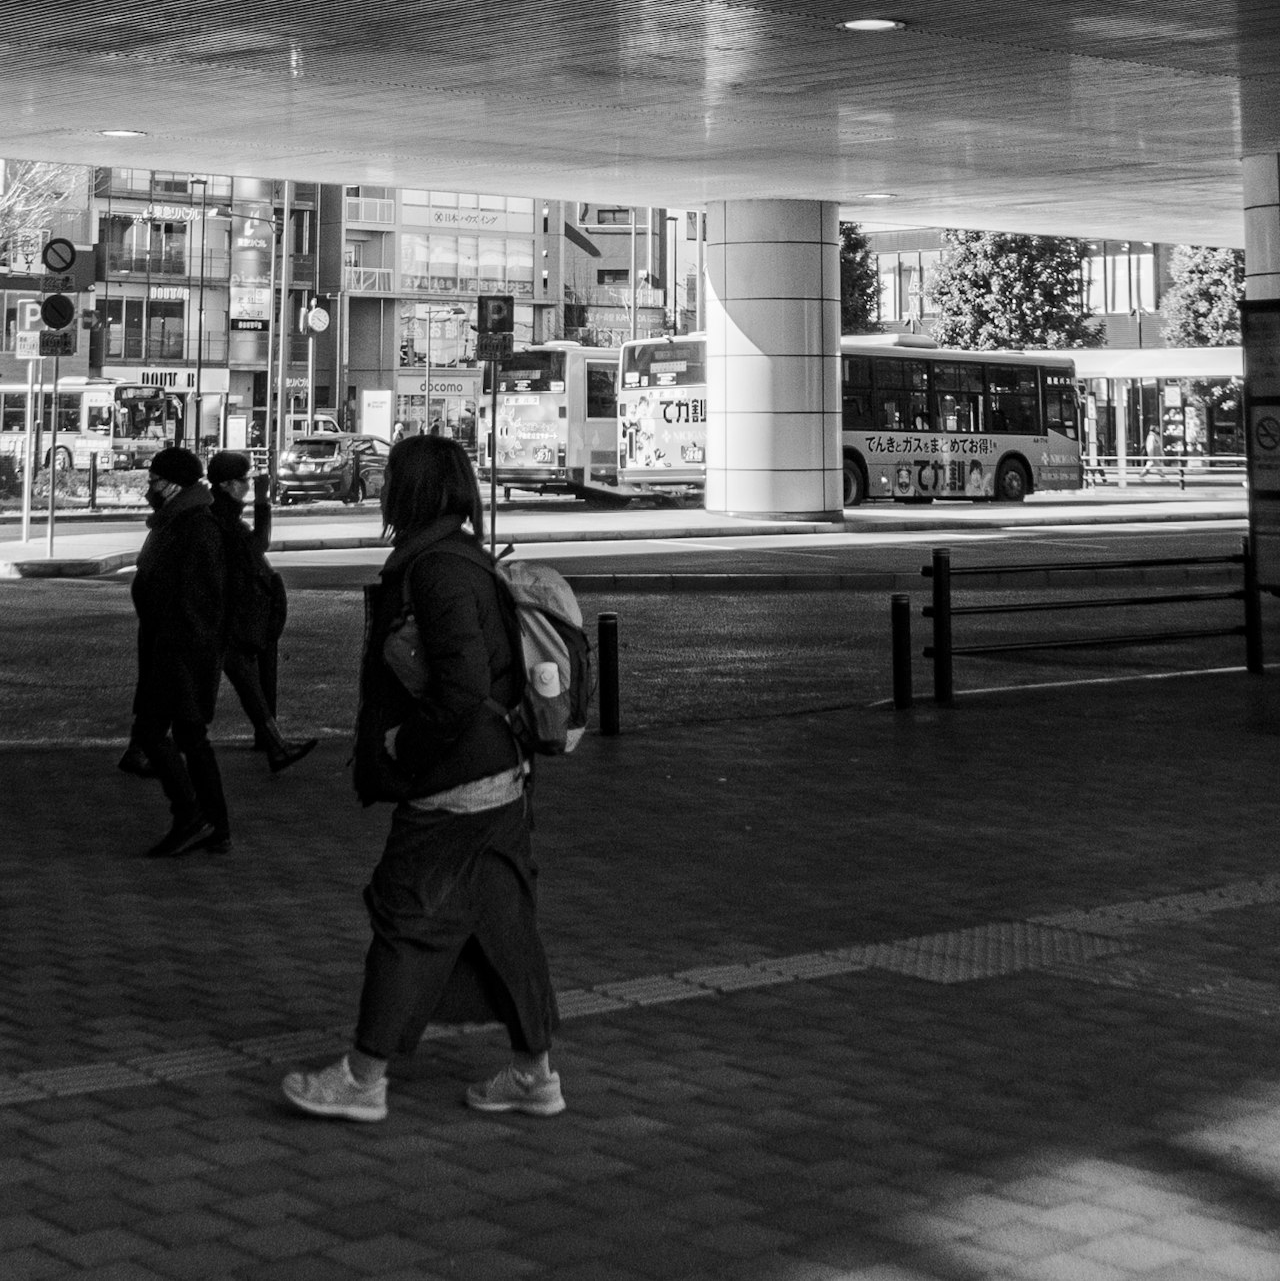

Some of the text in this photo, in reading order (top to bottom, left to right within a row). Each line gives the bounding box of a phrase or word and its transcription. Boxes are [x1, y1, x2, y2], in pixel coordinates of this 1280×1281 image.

[25, 303, 42, 330] P
[487, 299, 507, 329] P
[420, 379, 463, 393] docomo
